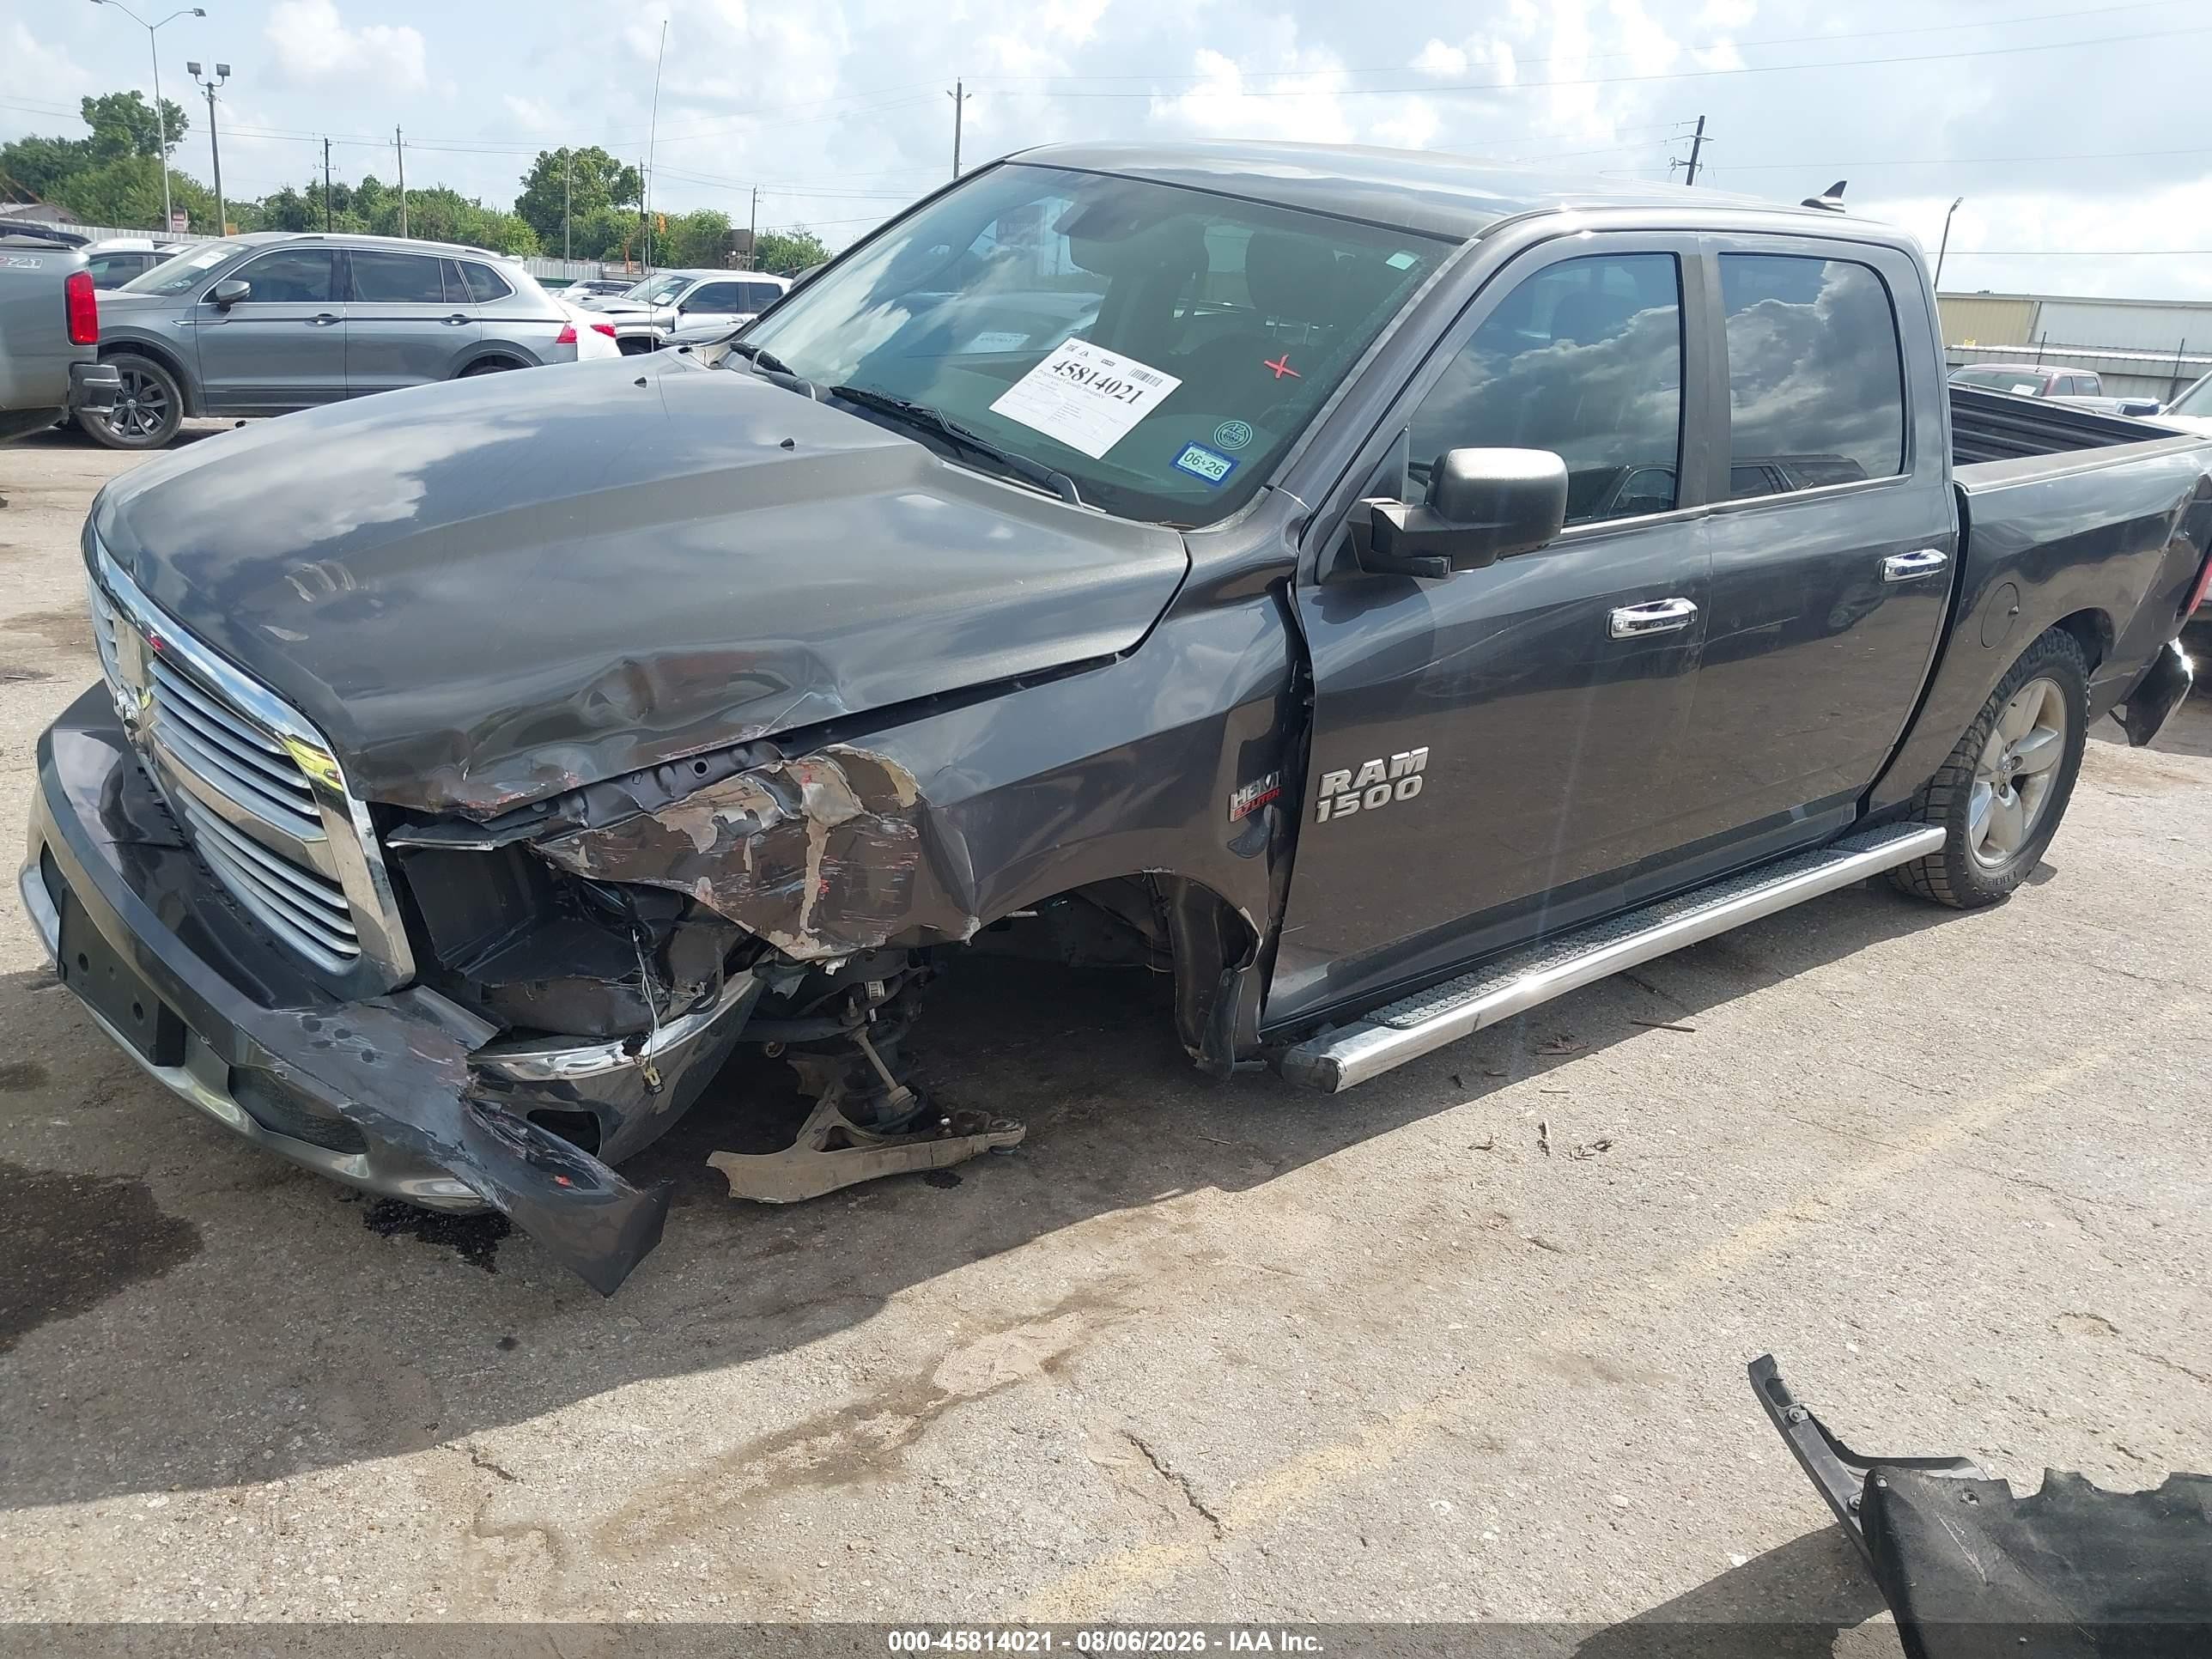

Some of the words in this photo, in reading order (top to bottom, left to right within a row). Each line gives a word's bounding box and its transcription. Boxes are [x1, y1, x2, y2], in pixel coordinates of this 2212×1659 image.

[1052, 360, 1145, 405] 45814021
[1183, 452, 1202, 465] 06
[1205, 461, 1224, 476] 26
[1230, 770, 1279, 809] HEMI
[1319, 746, 1429, 797] RAM
[1316, 775, 1423, 823] 1500
